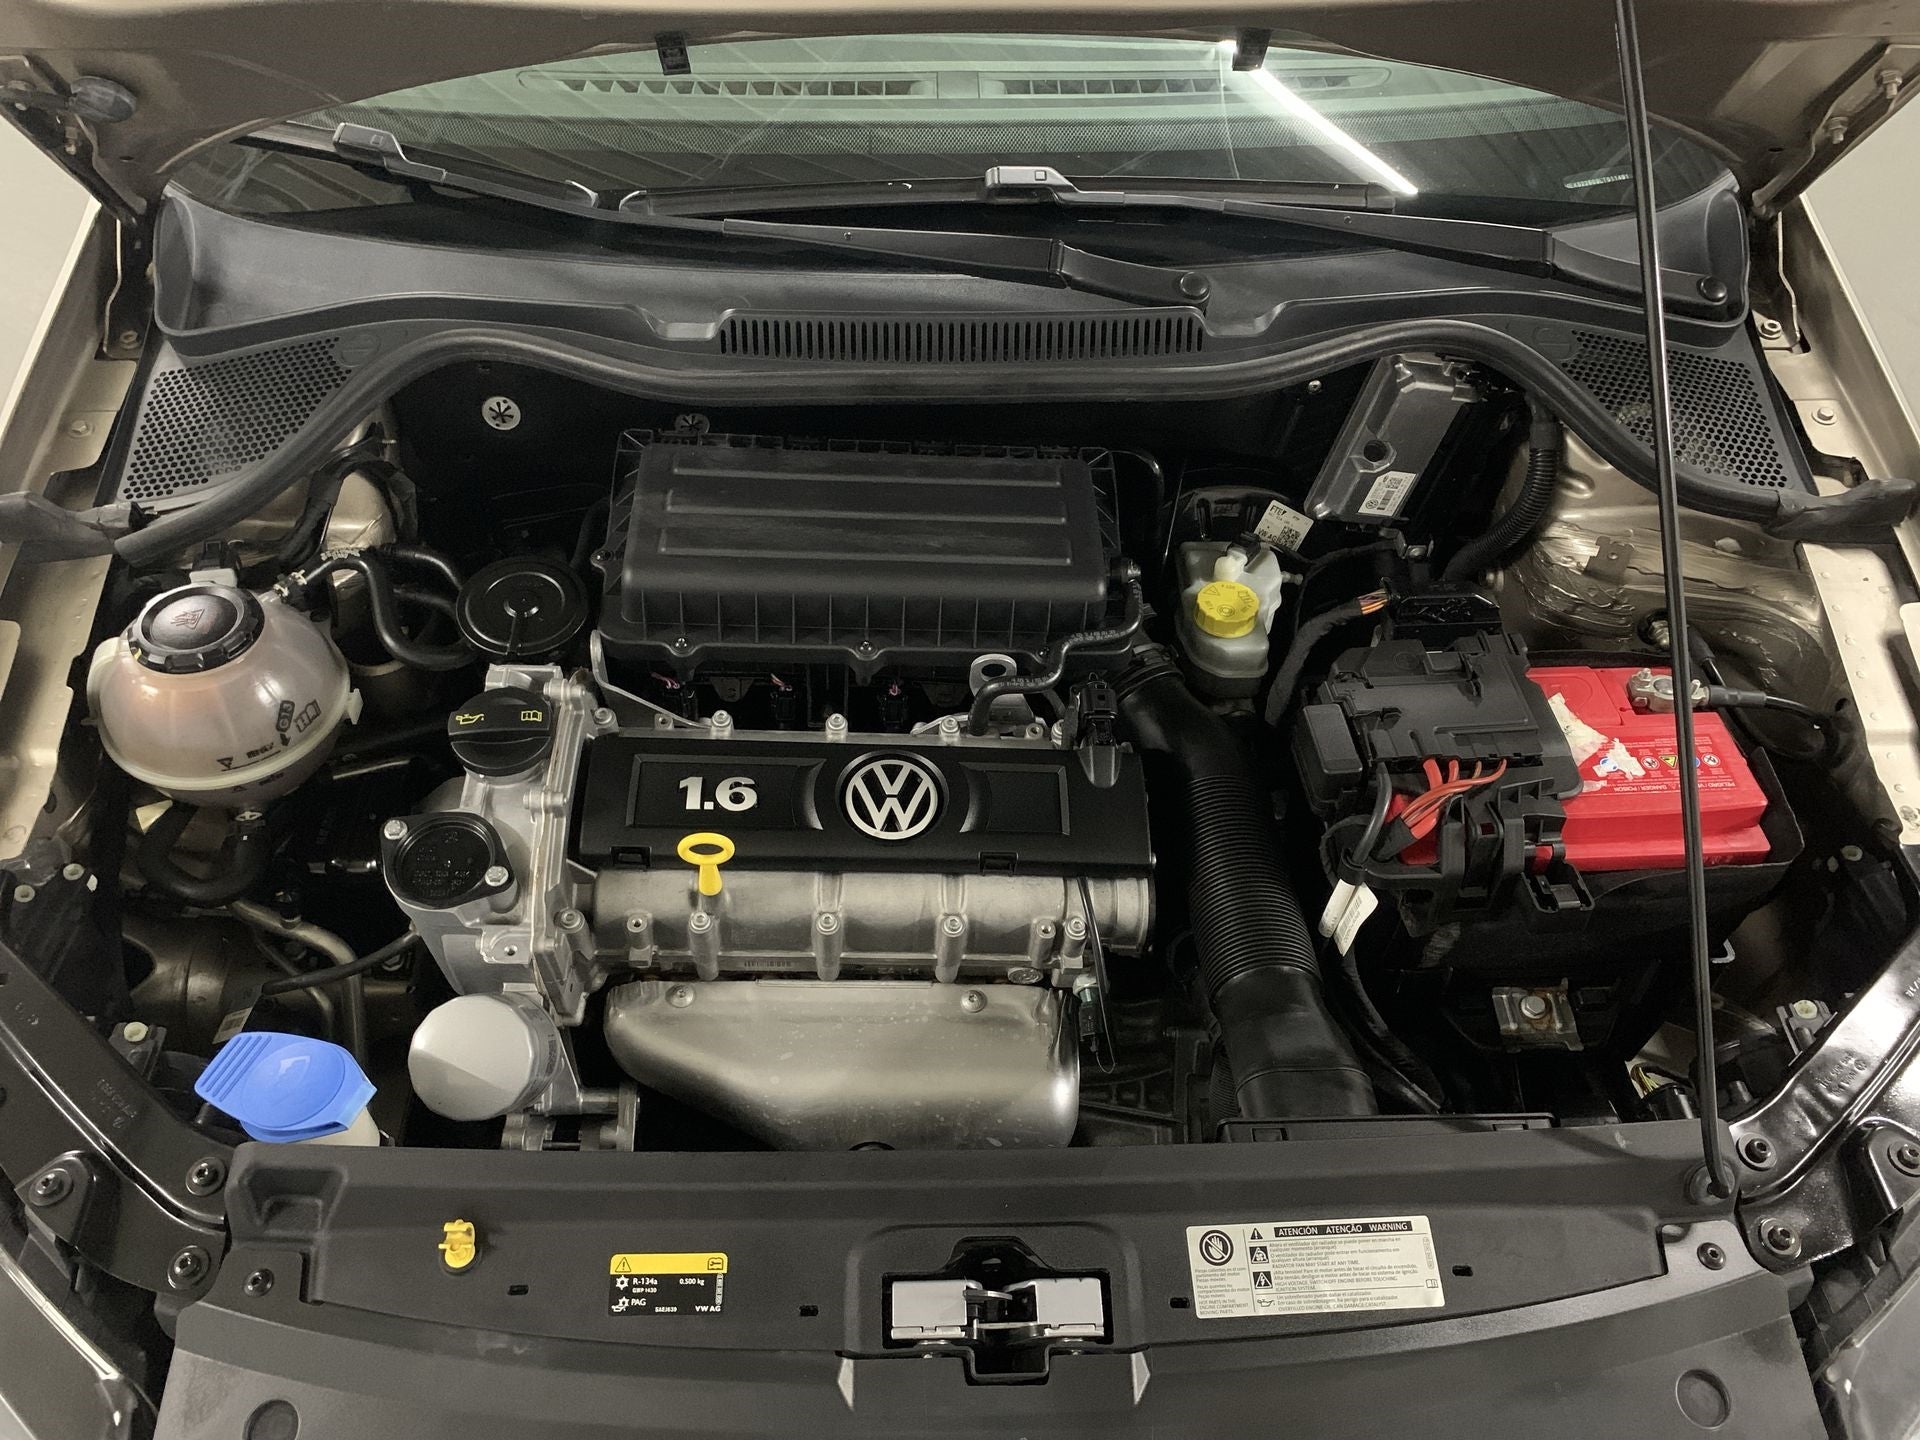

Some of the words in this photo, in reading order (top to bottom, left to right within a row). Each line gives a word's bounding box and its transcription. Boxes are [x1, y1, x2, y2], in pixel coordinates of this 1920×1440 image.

[279, 703, 292, 728] G13
[680, 776, 758, 812] 1.6
[846, 759, 938, 840] VW
[1278, 1226, 1318, 1236] ATENCIÓN
[1326, 1223, 1362, 1234] ATENÇÃO
[1368, 1222, 1408, 1232] WARNING
[632, 1278, 658, 1286] R-134a
[698, 1278, 705, 1286] kg
[631, 1298, 646, 1306] PAG
